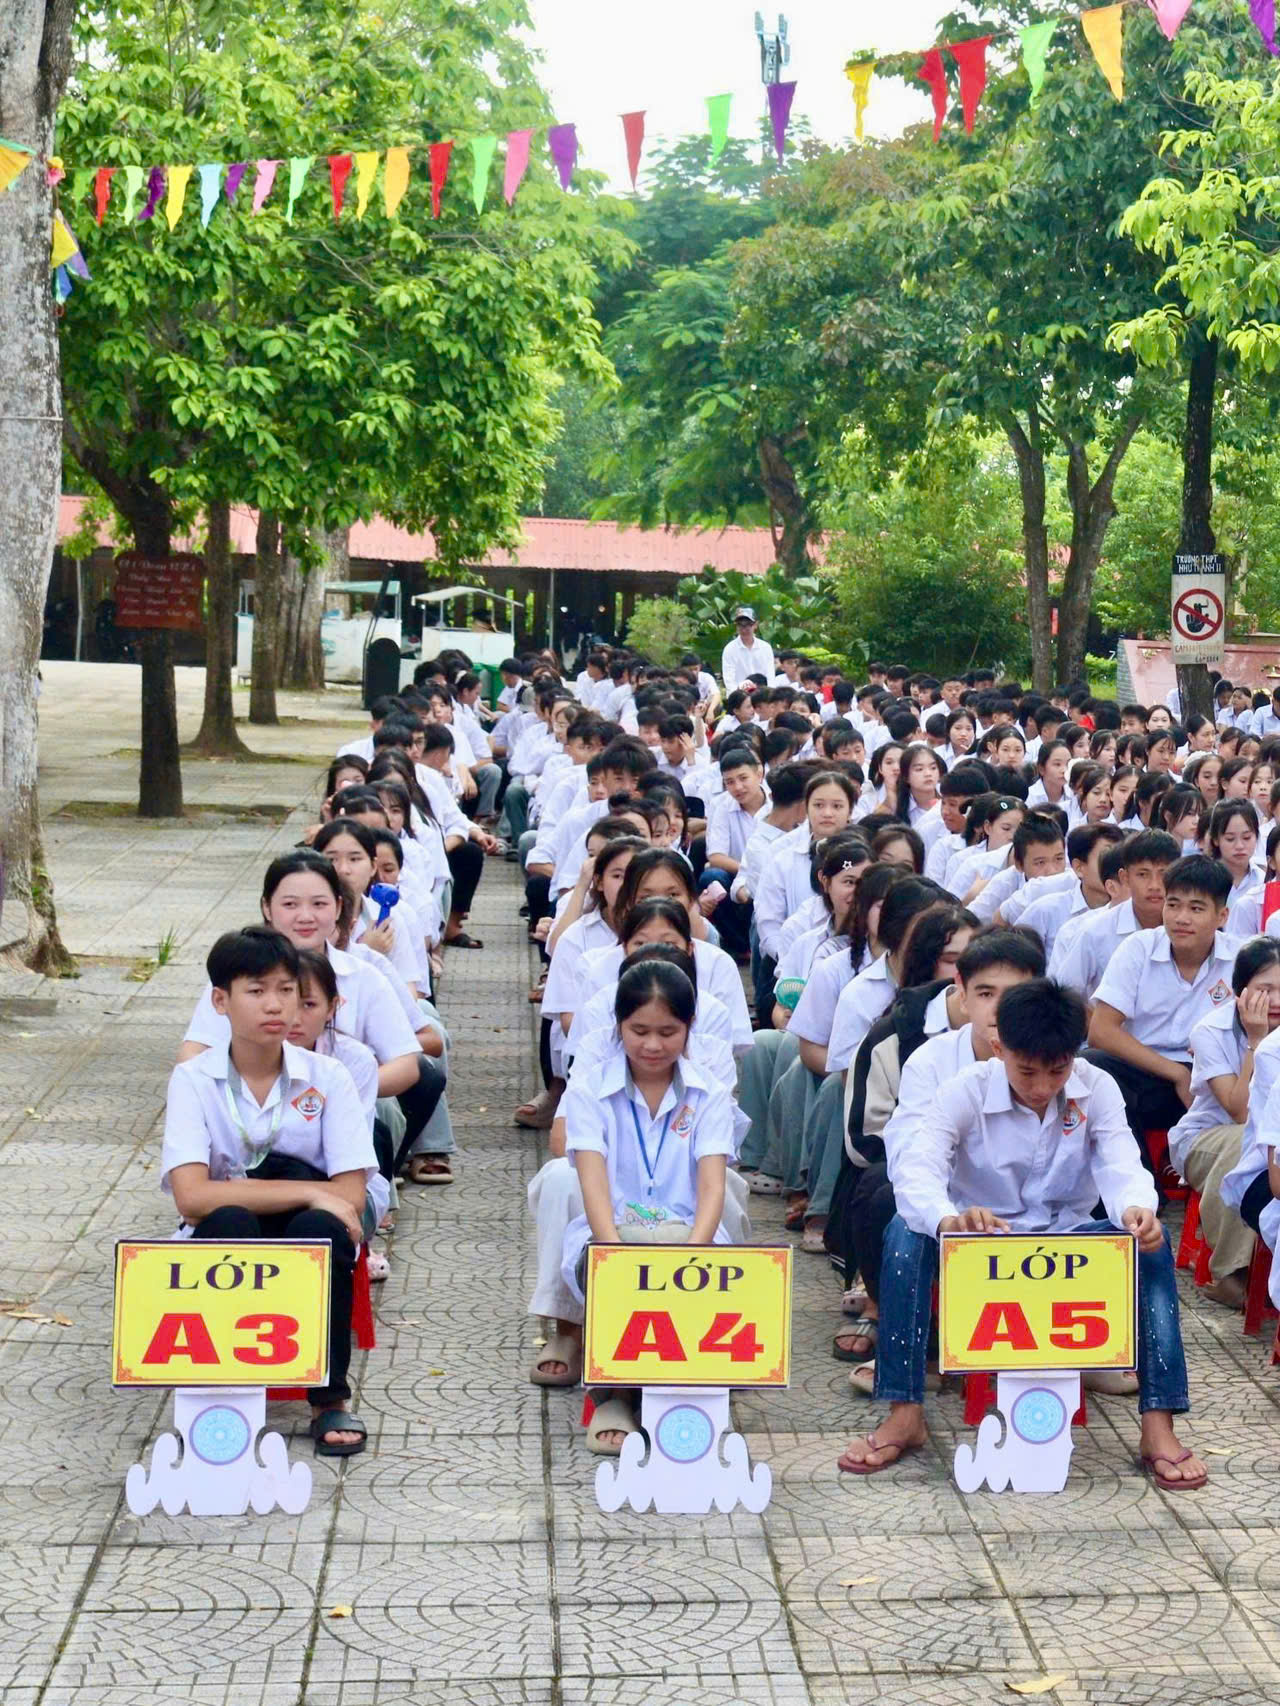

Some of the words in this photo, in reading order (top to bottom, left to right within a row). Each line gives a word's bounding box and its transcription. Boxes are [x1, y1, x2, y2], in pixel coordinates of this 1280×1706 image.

[168, 1254, 281, 1290] LỚP
[637, 1256, 746, 1292] LỚP
[986, 1246, 1090, 1281] LỚP
[142, 1313, 299, 1365] A3
[612, 1312, 764, 1362] A4
[967, 1301, 1110, 1351] A5
